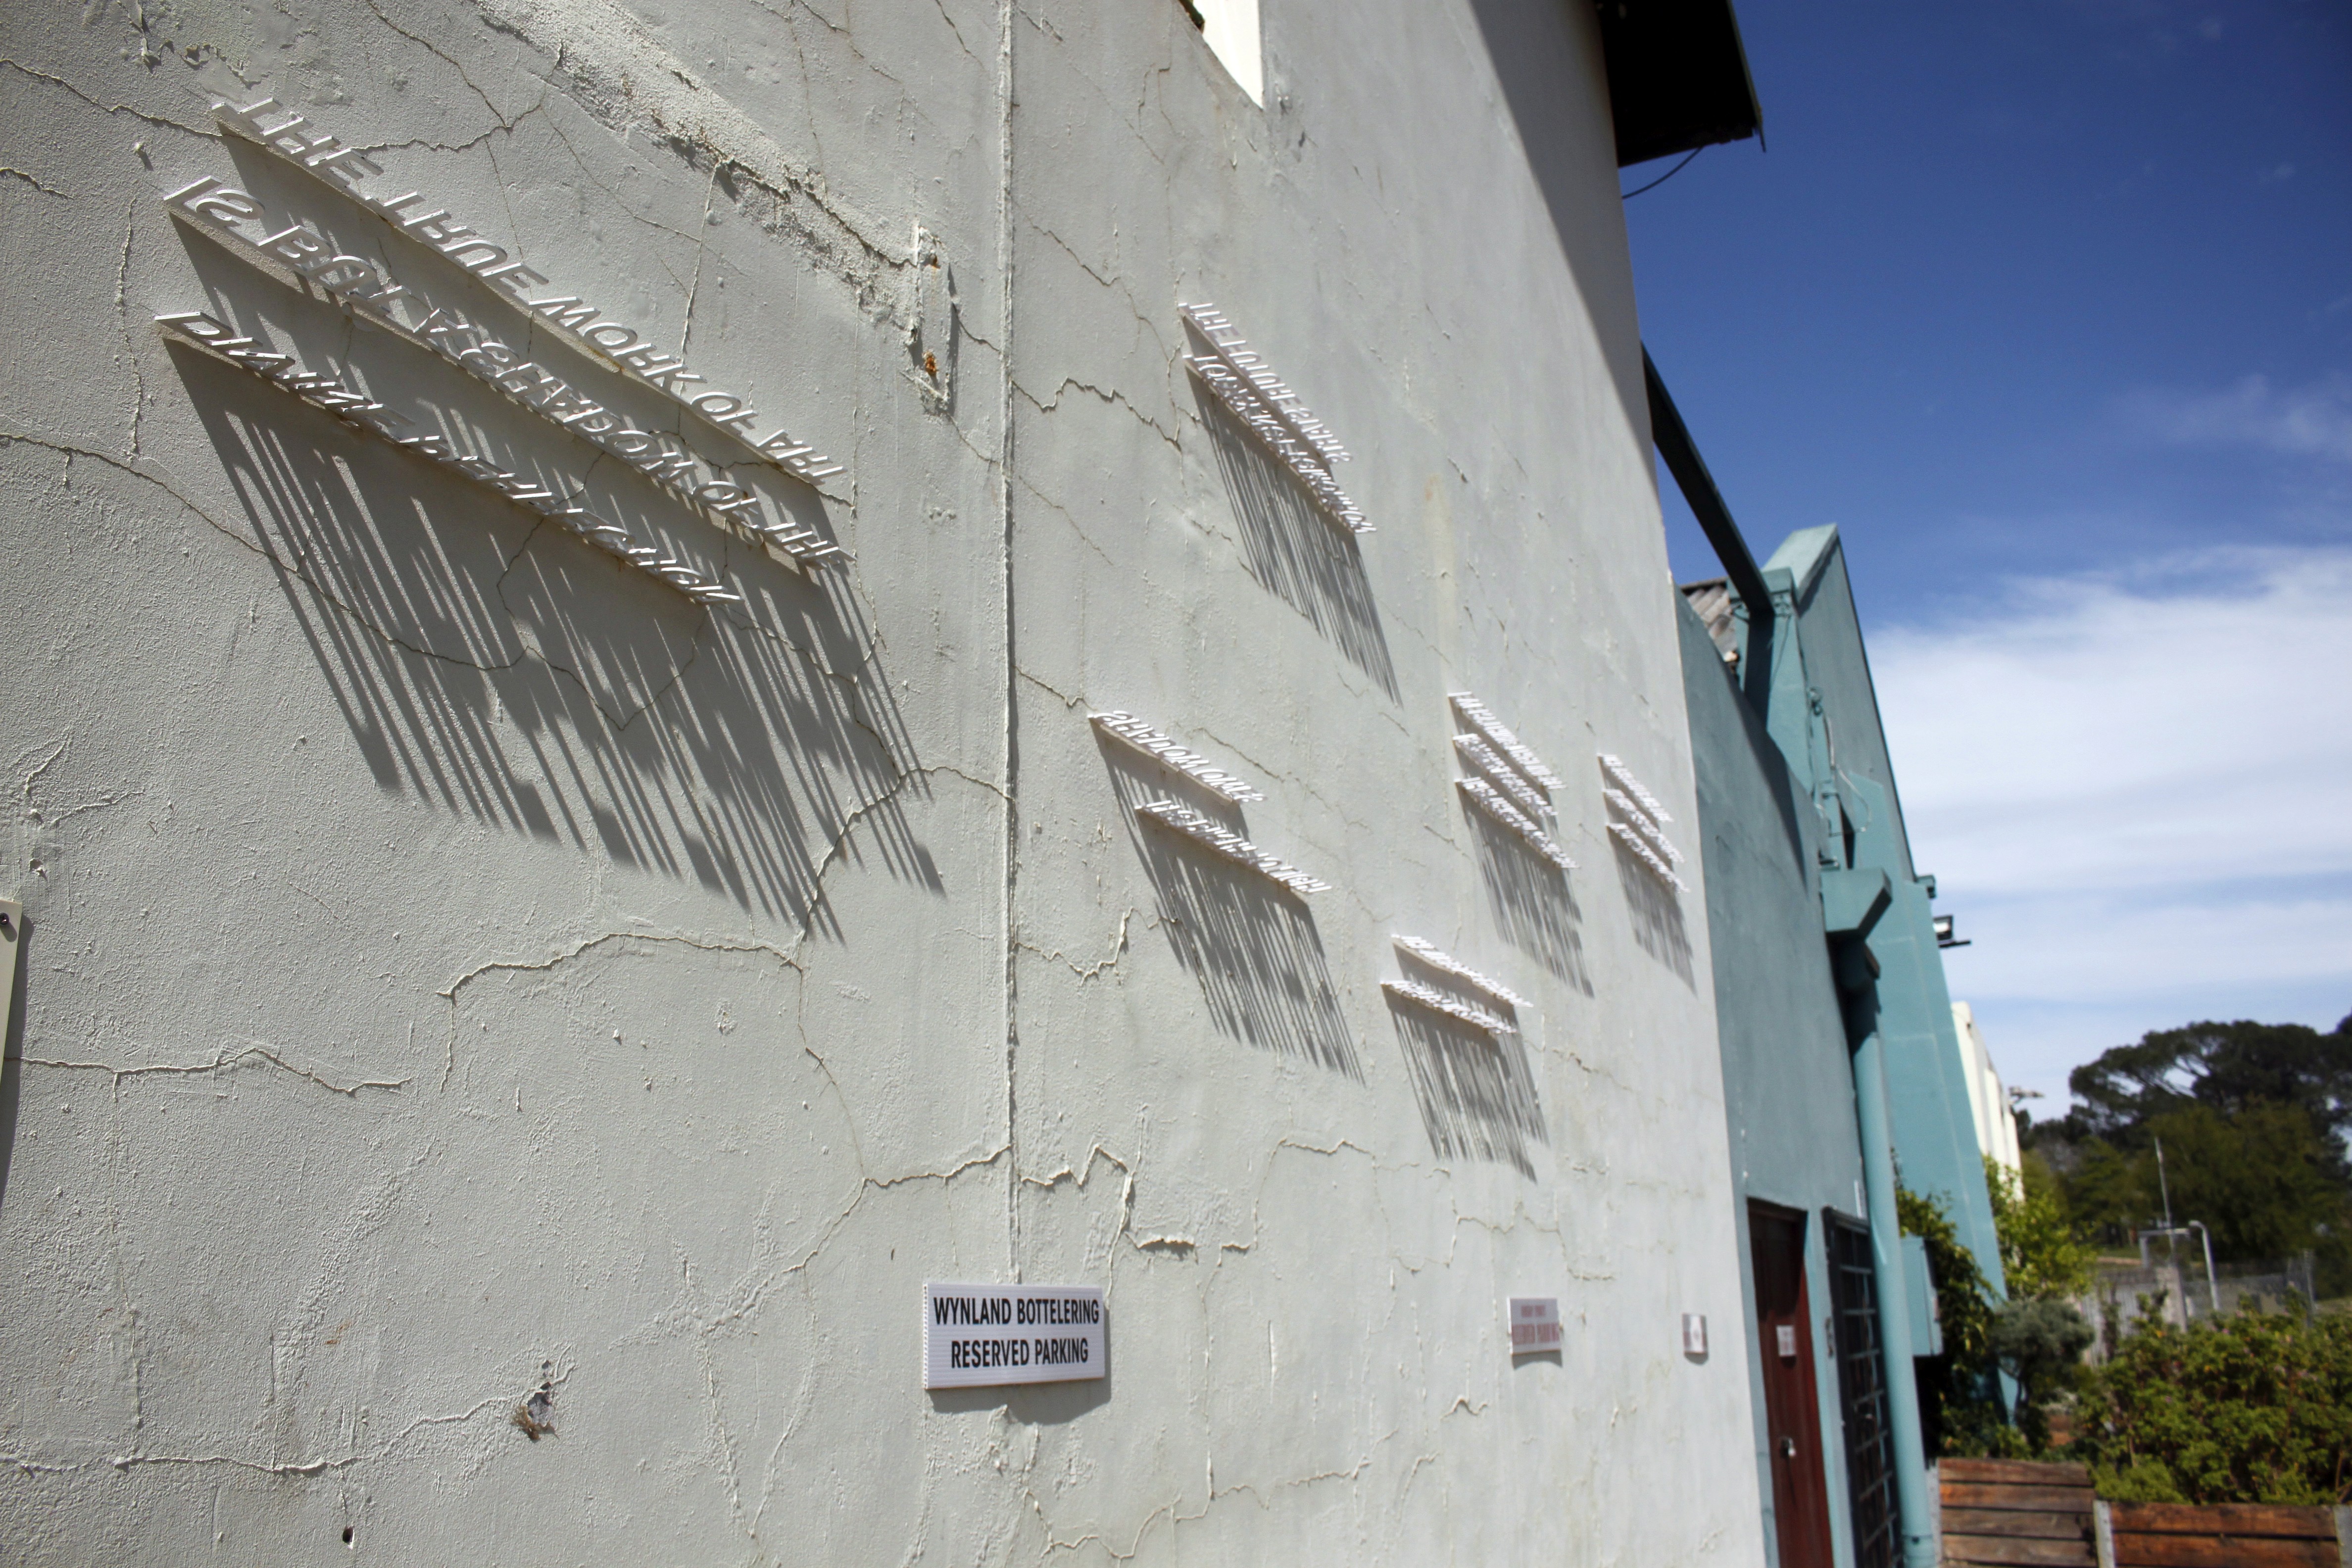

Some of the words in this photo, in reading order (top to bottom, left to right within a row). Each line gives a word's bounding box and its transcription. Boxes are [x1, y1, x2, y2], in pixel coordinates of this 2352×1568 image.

[933, 1296, 1012, 1325] WYNLAND
[1017, 1298, 1099, 1324] BOTTELERING
[951, 1339, 1030, 1369] RESERVED
[1034, 1338, 1088, 1365] PARKING
